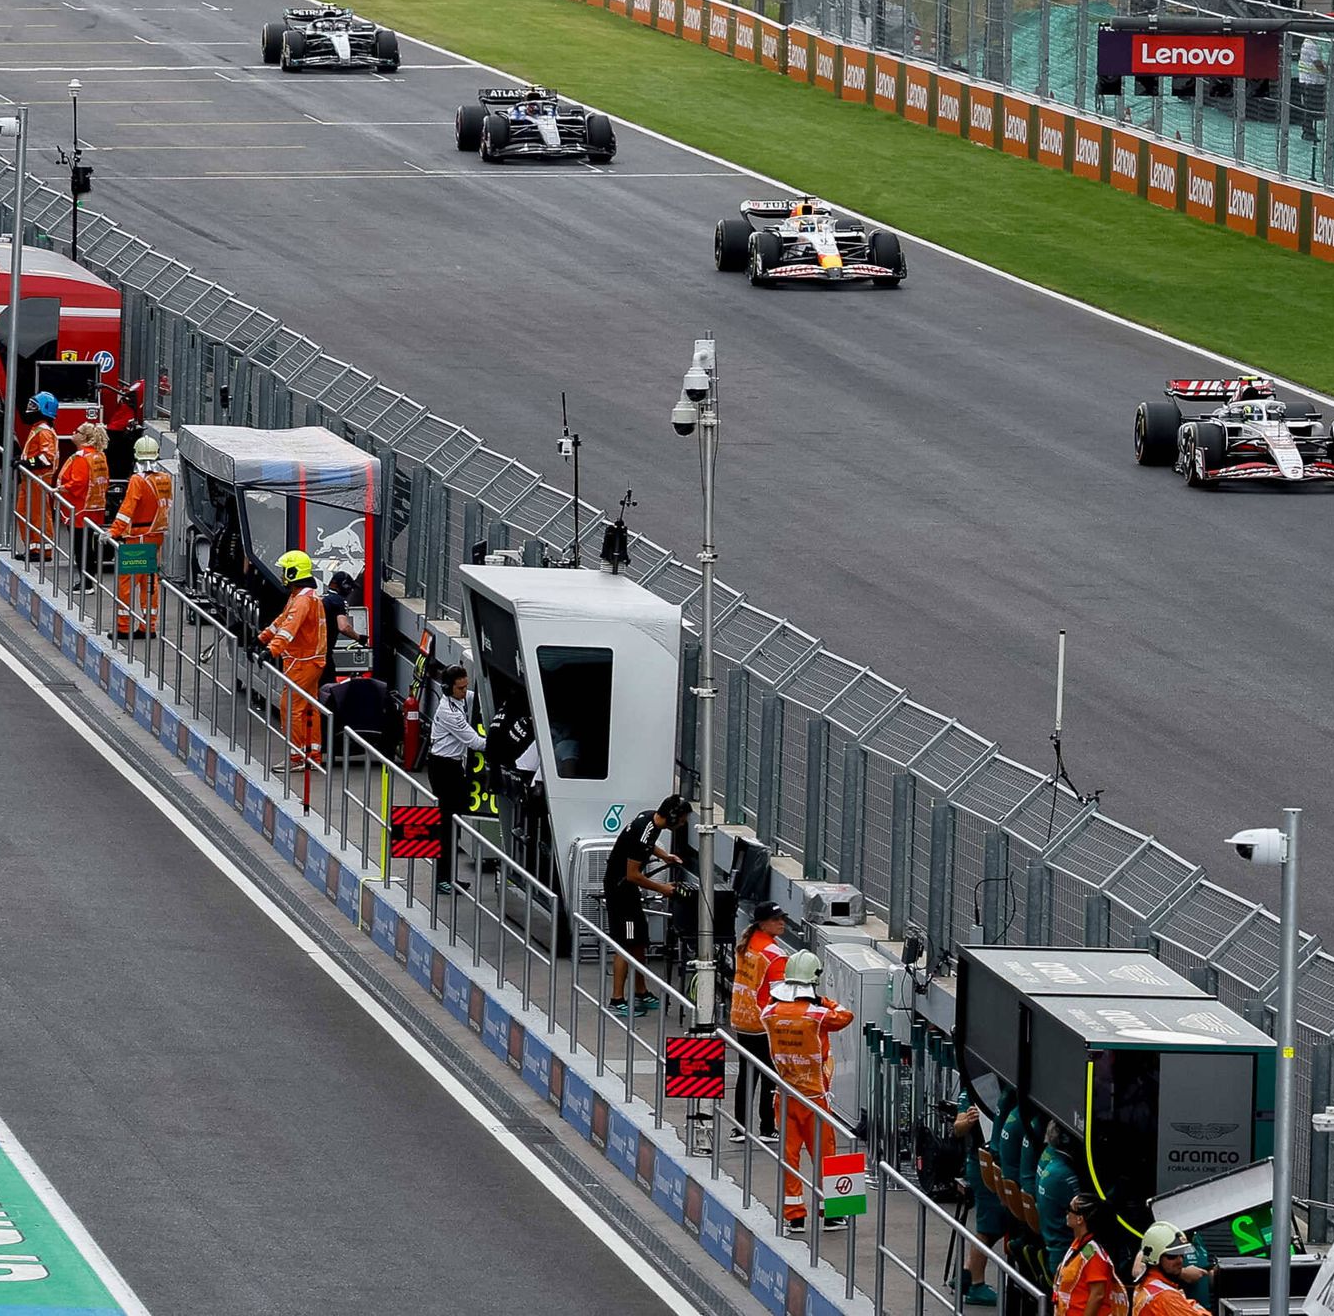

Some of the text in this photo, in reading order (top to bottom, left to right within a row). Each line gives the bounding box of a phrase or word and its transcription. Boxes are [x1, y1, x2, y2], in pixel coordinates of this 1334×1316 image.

[788, 39, 807, 71] Lenovo
[816, 45, 834, 81] Lenovo
[1141, 42, 1235, 66] Lenovo
[843, 56, 866, 91] Lenovo
[875, 64, 896, 101] Lenovo
[906, 75, 928, 112] Lenovo
[938, 86, 960, 122] Lenovo
[970, 95, 993, 132] Lenovo
[1004, 107, 1028, 145] Lenovo
[1039, 118, 1063, 156] Lenovo
[1075, 129, 1100, 167] Lenovo
[1112, 138, 1137, 179] Lenovo
[1149, 153, 1176, 194] Lenovo
[1188, 167, 1214, 208] Lenovo
[1227, 179, 1255, 220] Lenovo
[1269, 192, 1298, 234] Lenovo
[1168, 1148, 1240, 1164] aramco
